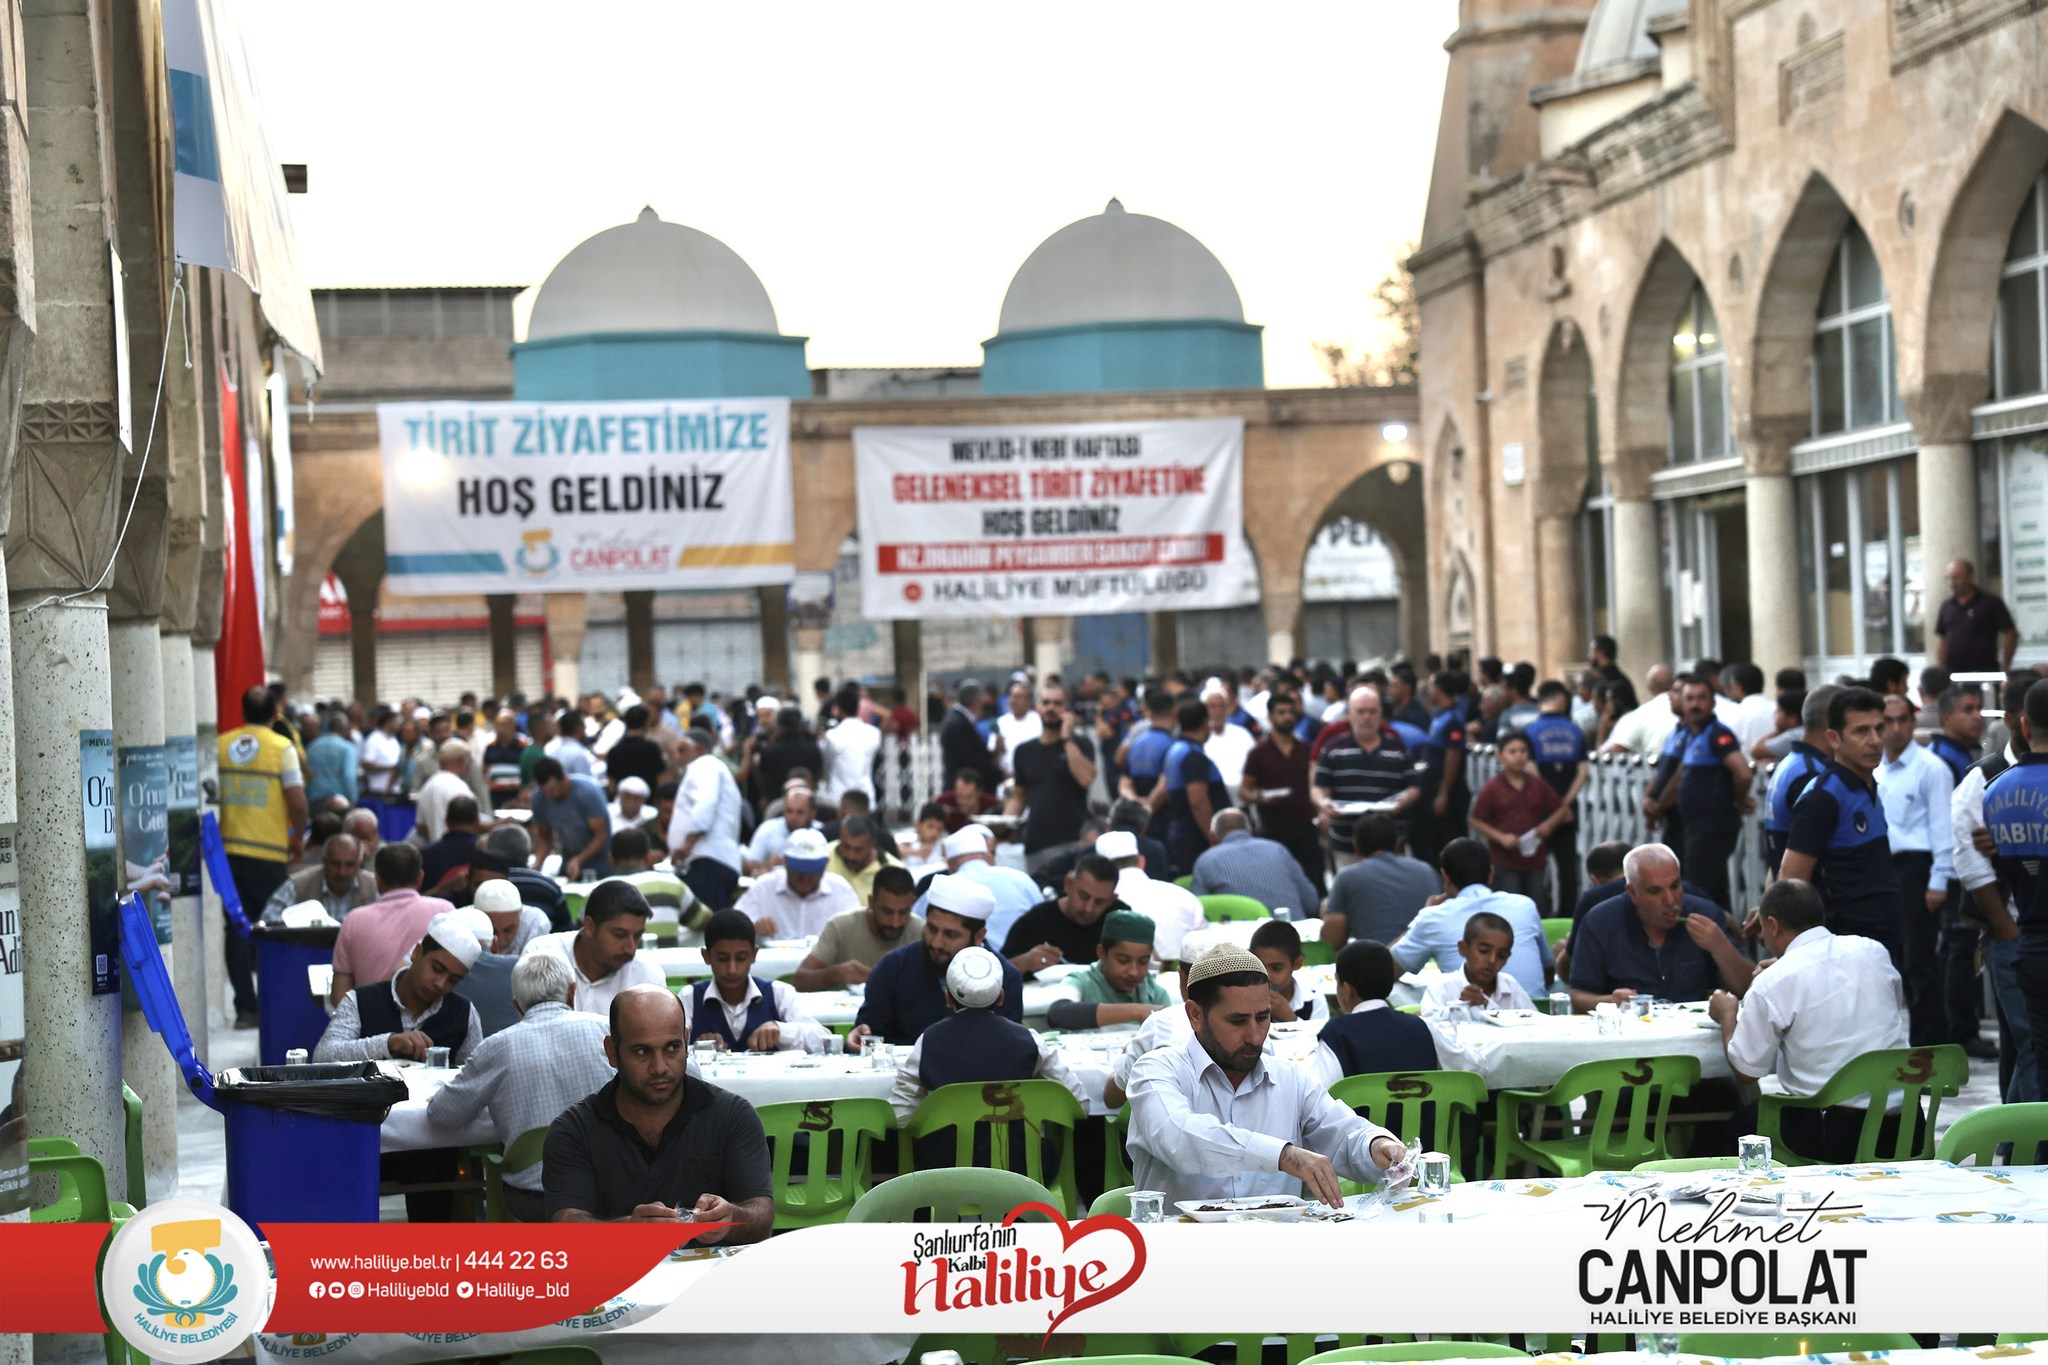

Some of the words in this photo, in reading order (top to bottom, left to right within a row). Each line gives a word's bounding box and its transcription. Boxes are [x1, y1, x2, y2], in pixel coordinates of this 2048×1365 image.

[404, 410, 499, 457] TİRİT
[513, 405, 769, 456] ZİYAFETİMİZE
[458, 476, 536, 520] HOŞ
[551, 465, 725, 515] GELDİNİZ
[892, 471, 1022, 504] GELENEKSEL
[1029, 465, 1083, 499] TİRİT
[1090, 459, 1207, 498] ZİYAFETİNE
[982, 510, 1025, 536] HOŞ
[1031, 505, 1121, 533] GELDİNİZ
[933, 575, 1043, 600] HALİLİYE
